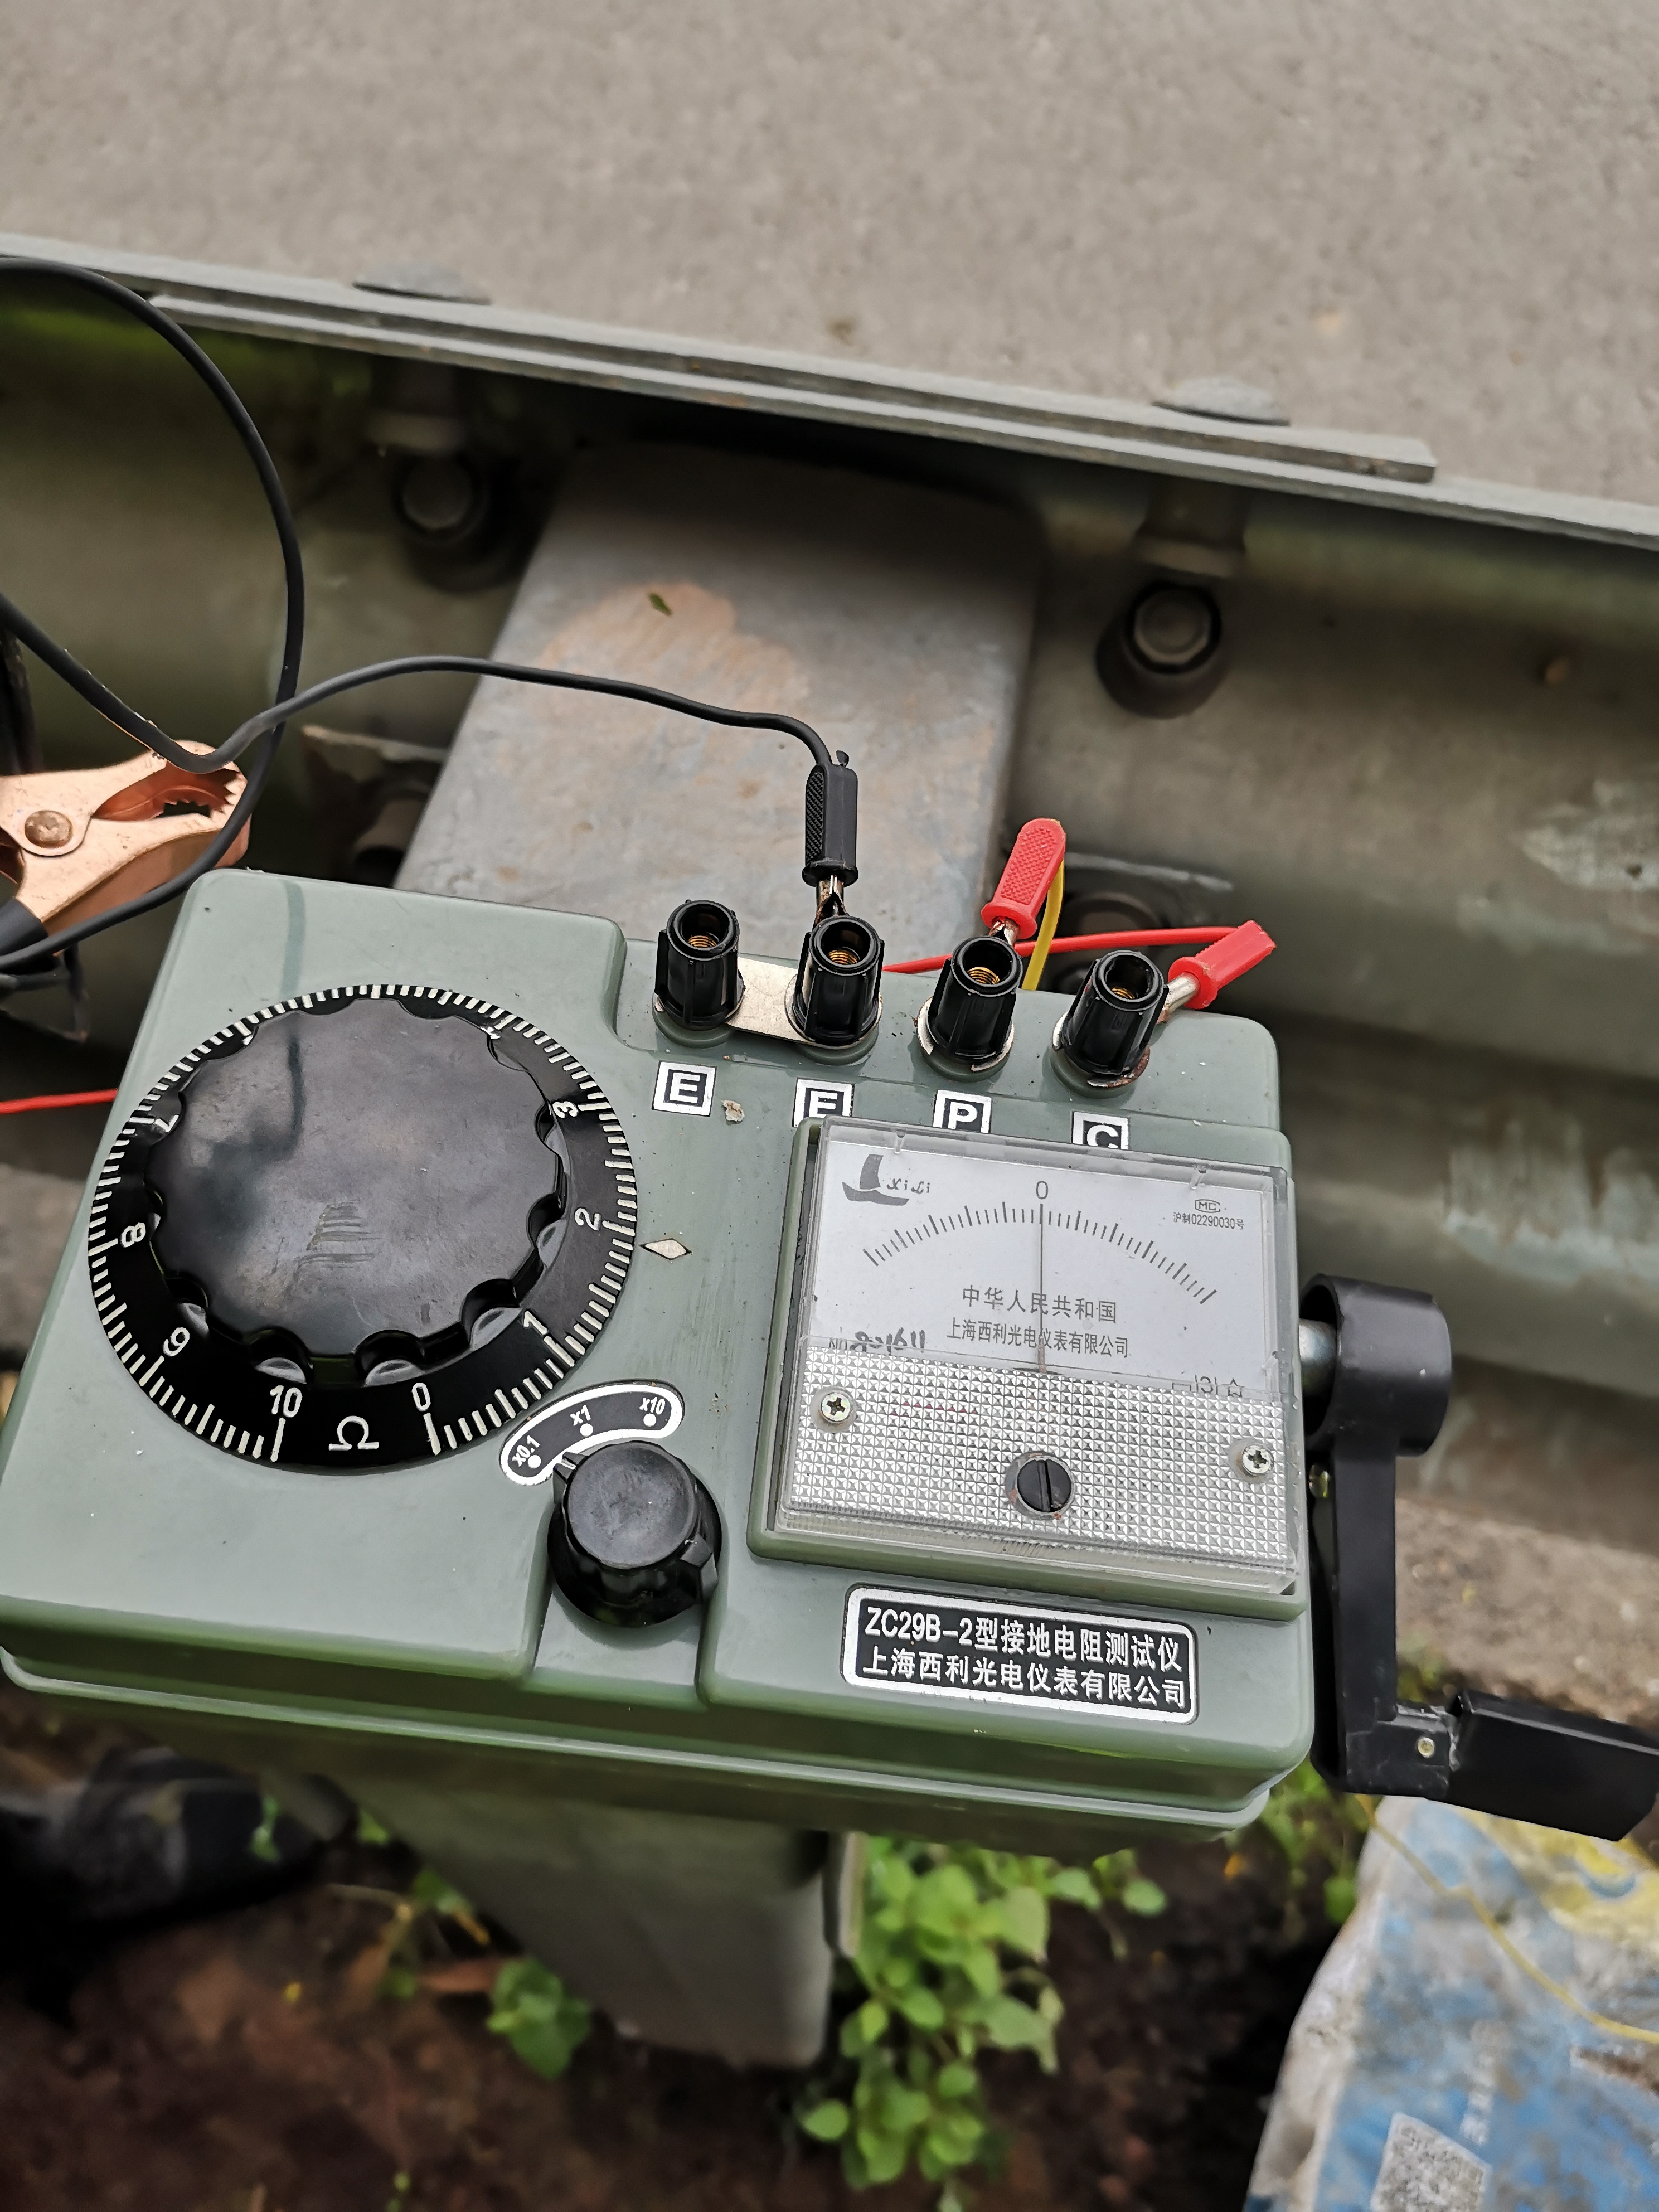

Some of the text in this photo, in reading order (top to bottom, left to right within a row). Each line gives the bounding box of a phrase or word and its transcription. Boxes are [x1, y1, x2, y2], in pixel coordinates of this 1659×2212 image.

[670, 1072, 700, 1104] E
[552, 1100, 579, 1118] 3
[948, 1102, 978, 1130] P
[1087, 1124, 1119, 1149] C
[1036, 1180, 1049, 1200] 0
[575, 1207, 601, 1231] 2
[119, 1222, 146, 1248] 8
[962, 1284, 1117, 1324] 中华人民共和国
[523, 1310, 548, 1336] 1
[946, 1317, 1129, 1359] 上海西利光电仪表有限公司
[162, 1327, 190, 1357] 9
[269, 1385, 303, 1418] 10
[411, 1382, 431, 1412] 0
[865, 1606, 1182, 1673] ZC29B-2型接地电阻测试仪
[862, 1645, 1186, 1710] 上海西利光电仪表有限公司
